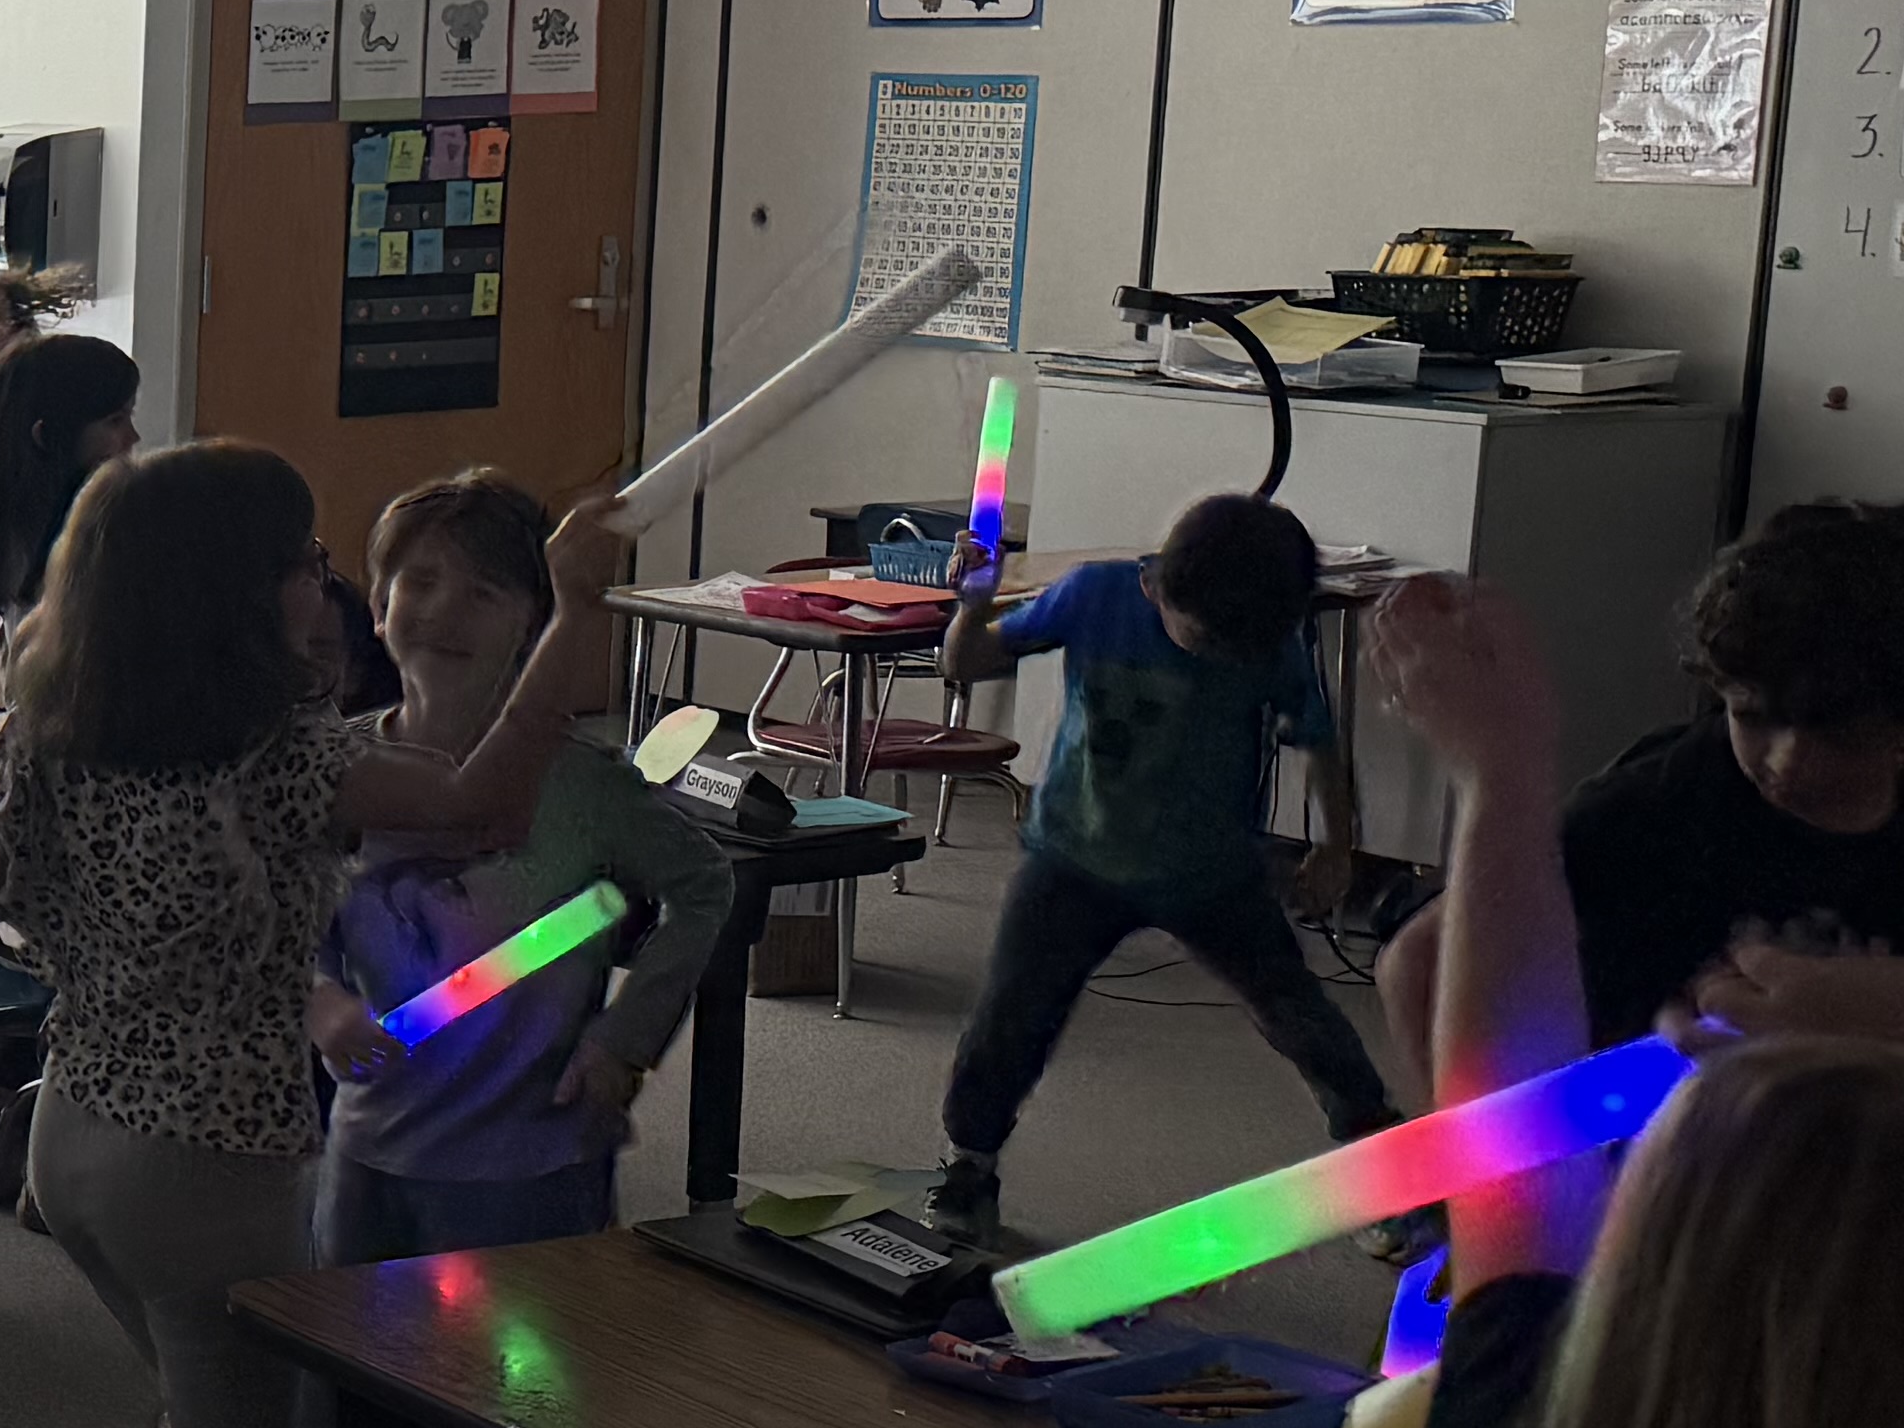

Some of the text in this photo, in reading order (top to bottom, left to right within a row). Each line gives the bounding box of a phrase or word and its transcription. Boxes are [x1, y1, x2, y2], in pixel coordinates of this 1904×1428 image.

[1856, 26, 1891, 75] 2.
[893, 82, 973, 98] Numbers
[980, 84, 1026, 98] 0-120
[881, 102, 886, 115] 1
[895, 103, 901, 116] 2
[910, 103, 916, 116] 3
[1011, 127, 1021, 140] 20
[1850, 113, 1884, 159] 3.
[1005, 188, 1015, 201] 50
[1002, 226, 1012, 239] 70
[1844, 205, 1876, 258] 4.
[686, 769, 738, 800] Grayson
[840, 1227, 940, 1270] Adalene
